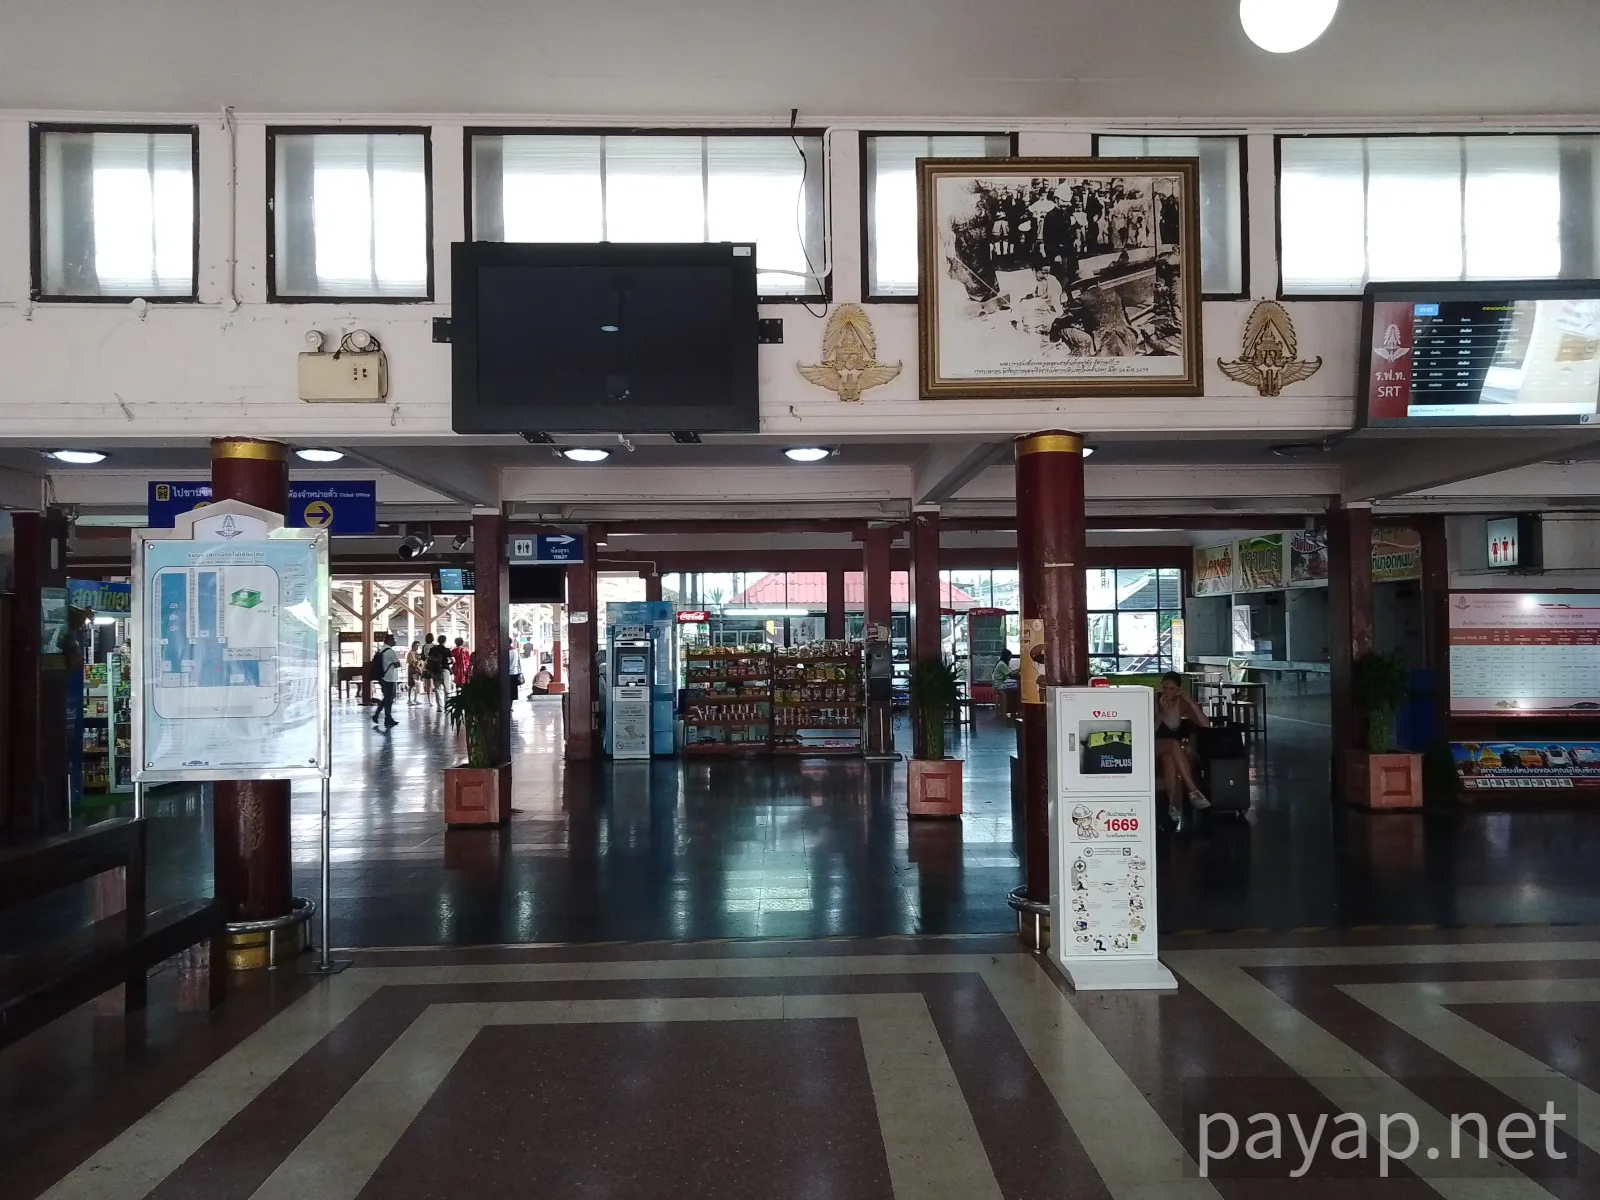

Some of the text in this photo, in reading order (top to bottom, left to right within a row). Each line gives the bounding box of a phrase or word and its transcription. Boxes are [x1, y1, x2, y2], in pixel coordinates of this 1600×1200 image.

[1375, 368, 1406, 381] ร.ฟ.ท.
[1377, 386, 1402, 397] SRT
[172, 486, 212, 497] ไปชานชา
[1480, 766, 1600, 776] สถานีเชียงใหม่ขอขอบคุณผู้ใช้บริกา
[1103, 818, 1138, 831] 1669
